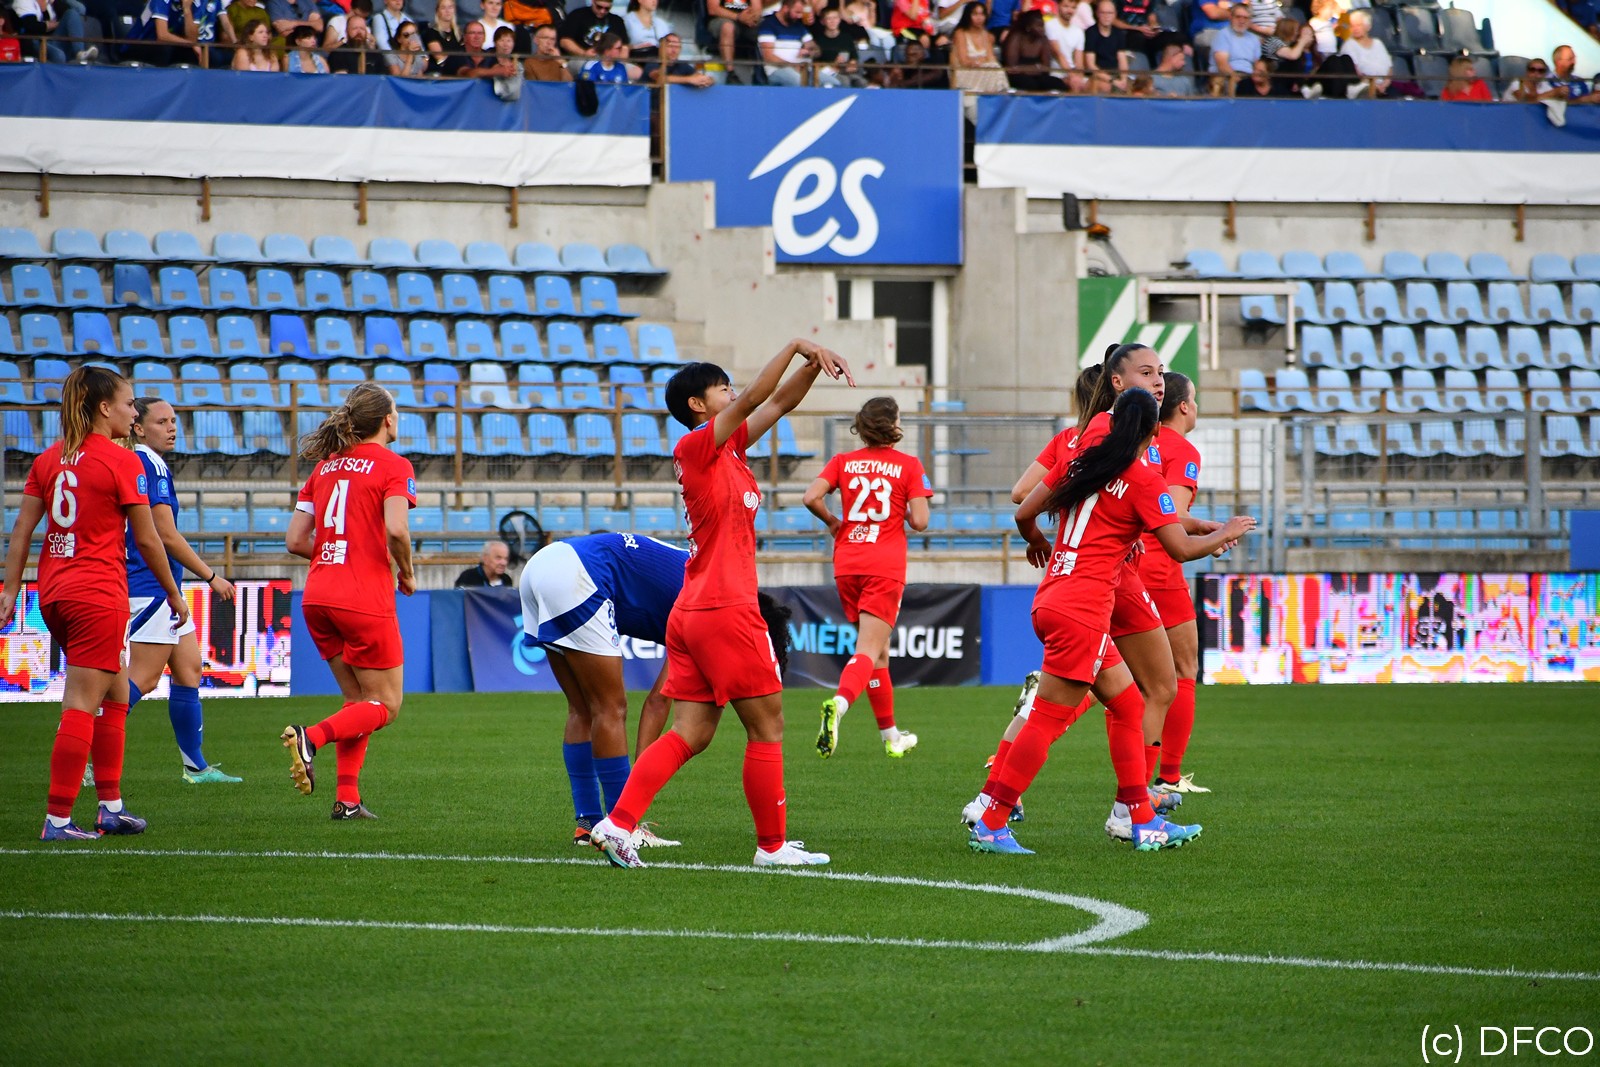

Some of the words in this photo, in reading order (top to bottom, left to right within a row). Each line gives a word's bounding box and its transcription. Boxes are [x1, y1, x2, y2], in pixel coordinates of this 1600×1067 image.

[320, 457, 374, 475] GOETSCH
[844, 461, 902, 479] KREZYMAN
[52, 470, 78, 528] 6
[324, 480, 349, 534] 4
[848, 476, 892, 522] 23
